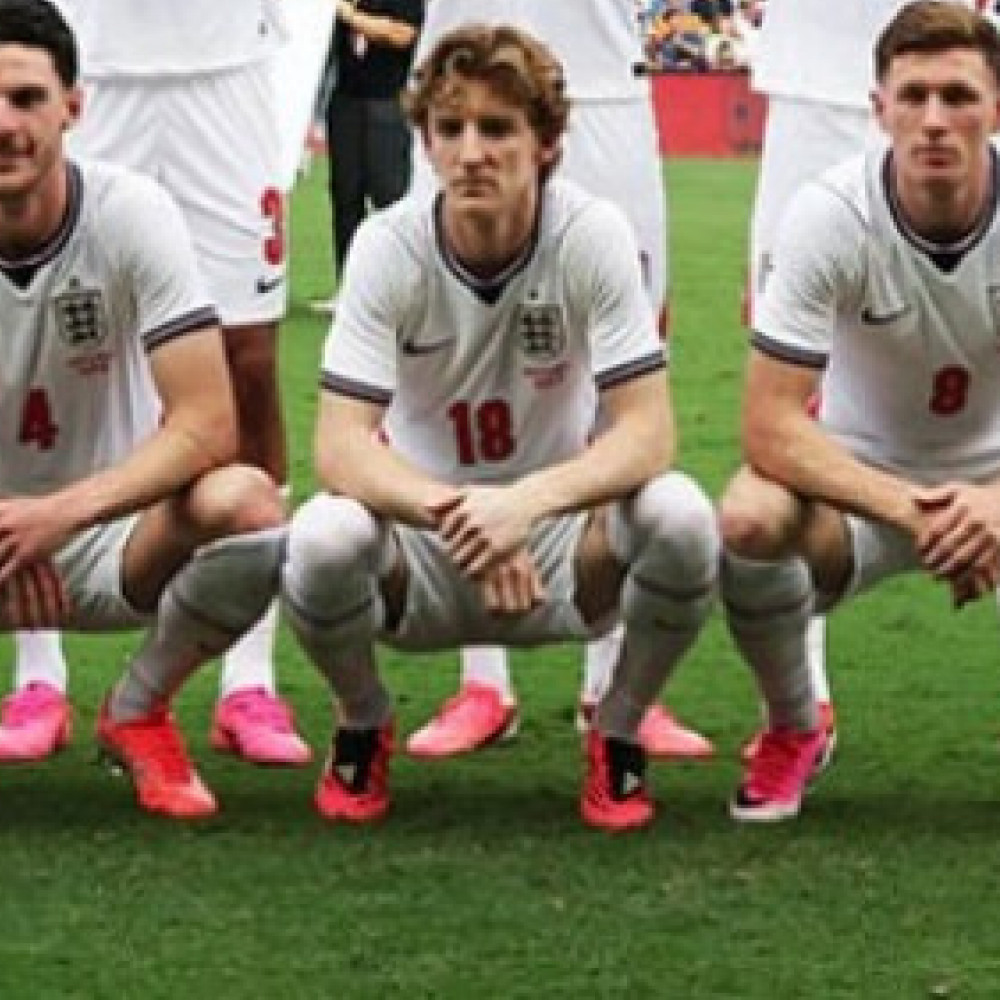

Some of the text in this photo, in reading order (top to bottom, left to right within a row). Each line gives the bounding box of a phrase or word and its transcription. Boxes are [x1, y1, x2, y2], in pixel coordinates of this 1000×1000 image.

[260, 186, 288, 268] 3
[18, 387, 60, 452] 4
[929, 366, 971, 417] 8
[446, 399, 517, 467] 18
